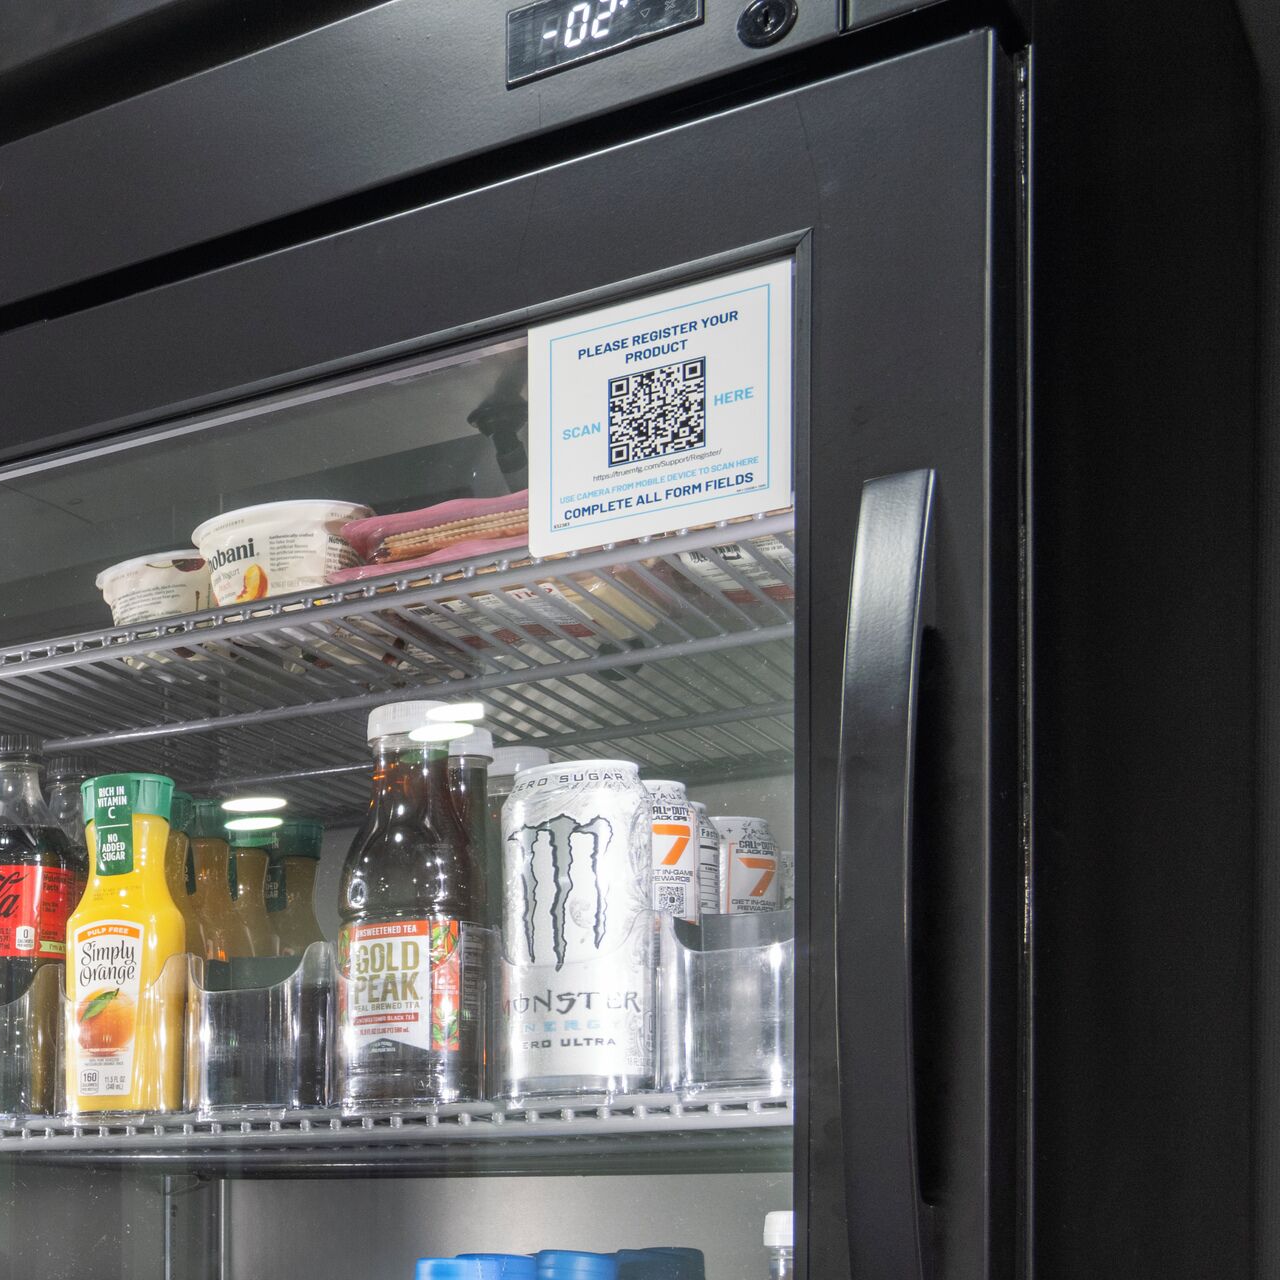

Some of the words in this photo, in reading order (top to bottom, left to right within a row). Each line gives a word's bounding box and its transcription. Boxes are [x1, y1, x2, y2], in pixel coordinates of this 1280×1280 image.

[578, 338, 629, 360] PLEASE
[632, 321, 698, 347] REGISTER
[701, 310, 739, 329] YOUR
[625, 339, 688, 364] PRODUCT
[713, 387, 754, 406] HERE
[562, 422, 601, 440] SCAN
[576, 487, 611, 502] CAMERA
[611, 482, 634, 496] FROM
[635, 476, 666, 491] MOBILE
[667, 470, 697, 485] DEVICE
[711, 462, 736, 475] SCAN
[736, 455, 760, 469] HERE
[564, 497, 633, 521] COMPLETE
[636, 492, 663, 506] ALL
[665, 483, 702, 500] FORM
[705, 472, 754, 492] FIELDS
[559, 771, 625, 784] SUGAR
[99, 786, 115, 797] RICH
[116, 785, 125, 795] IN
[97, 795, 127, 808] VITAMIN
[107, 807, 116, 819] C
[102, 842, 126, 852] ADDED
[107, 833, 118, 843] NO
[652, 824, 691, 866] 7
[102, 851, 126, 861] SUGAR
[736, 857, 777, 897] 7
[87, 927, 107, 937] PULP
[108, 926, 129, 935] FREE
[403, 924, 417, 933] TEA
[81, 940, 136, 967] Simply
[355, 941, 420, 973] GOLD
[80, 965, 135, 987] Orange
[355, 972, 421, 1005] PEAK
[560, 1037, 617, 1048] ULTRA
[83, 1072, 97, 1083] 160
